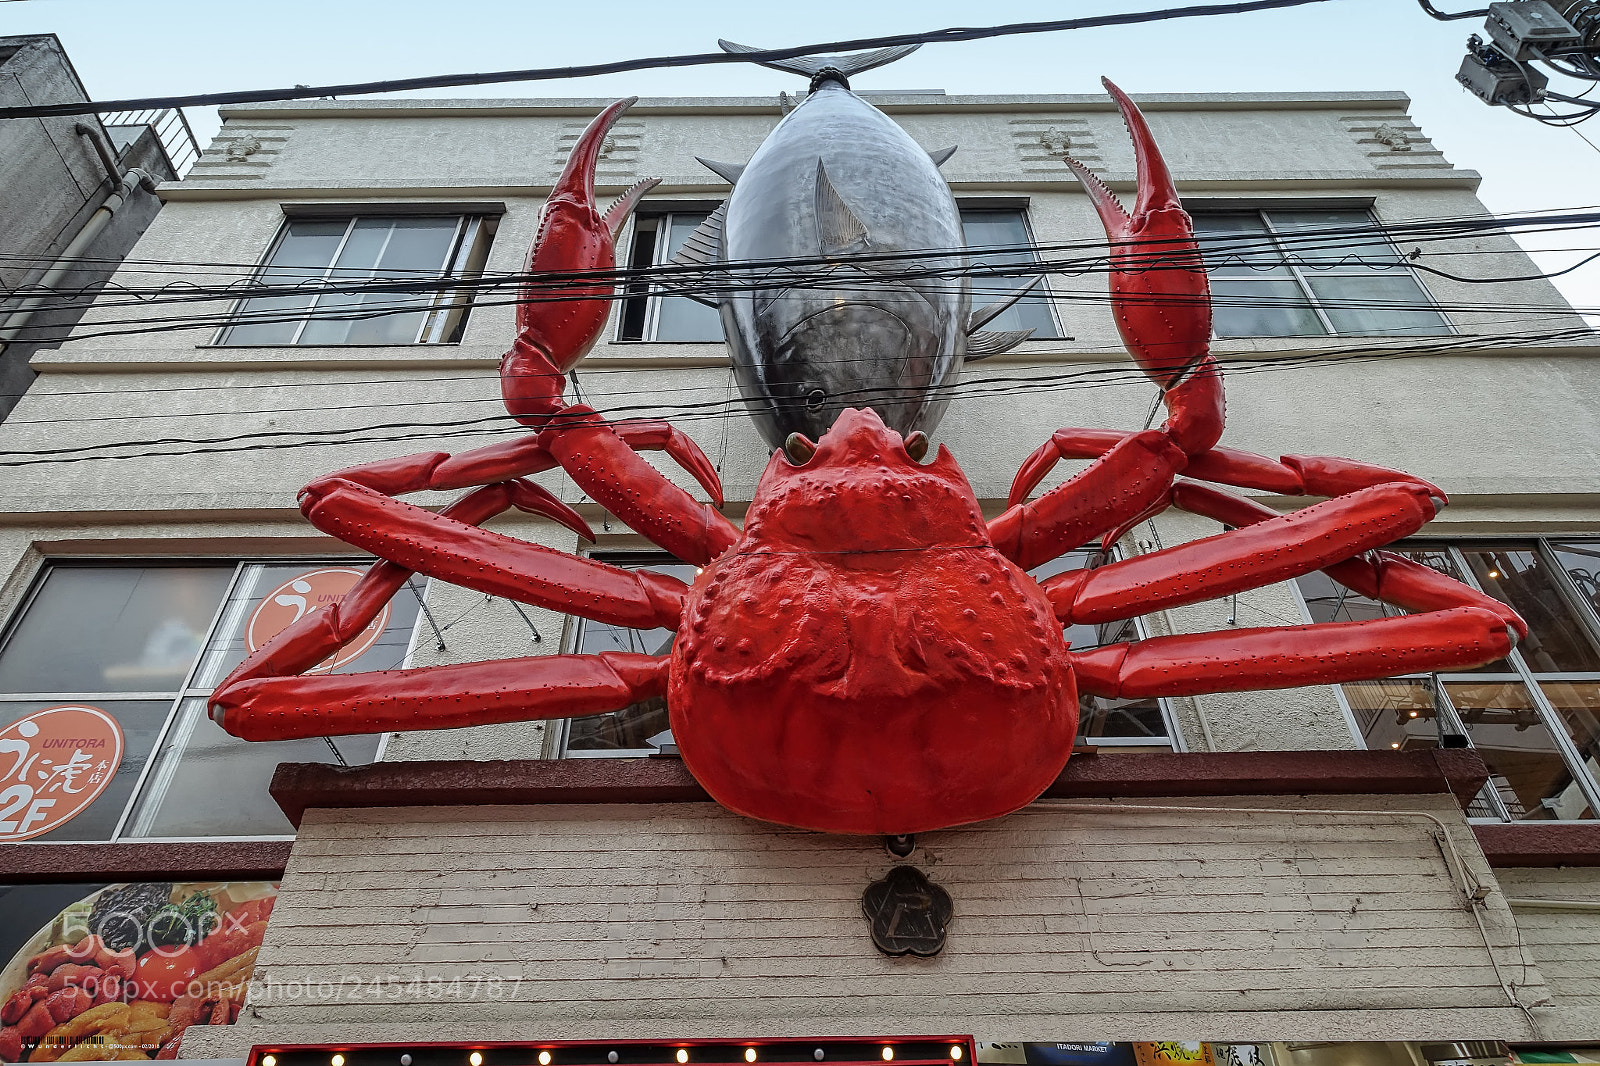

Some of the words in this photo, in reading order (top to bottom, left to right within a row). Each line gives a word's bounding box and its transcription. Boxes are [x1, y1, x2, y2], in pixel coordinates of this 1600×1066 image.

[42, 738, 105, 749] UNITORA
[87, 759, 110, 784] 本店
[0, 783, 57, 834] 2F
[1083, 1045, 1108, 1053] MARKET
